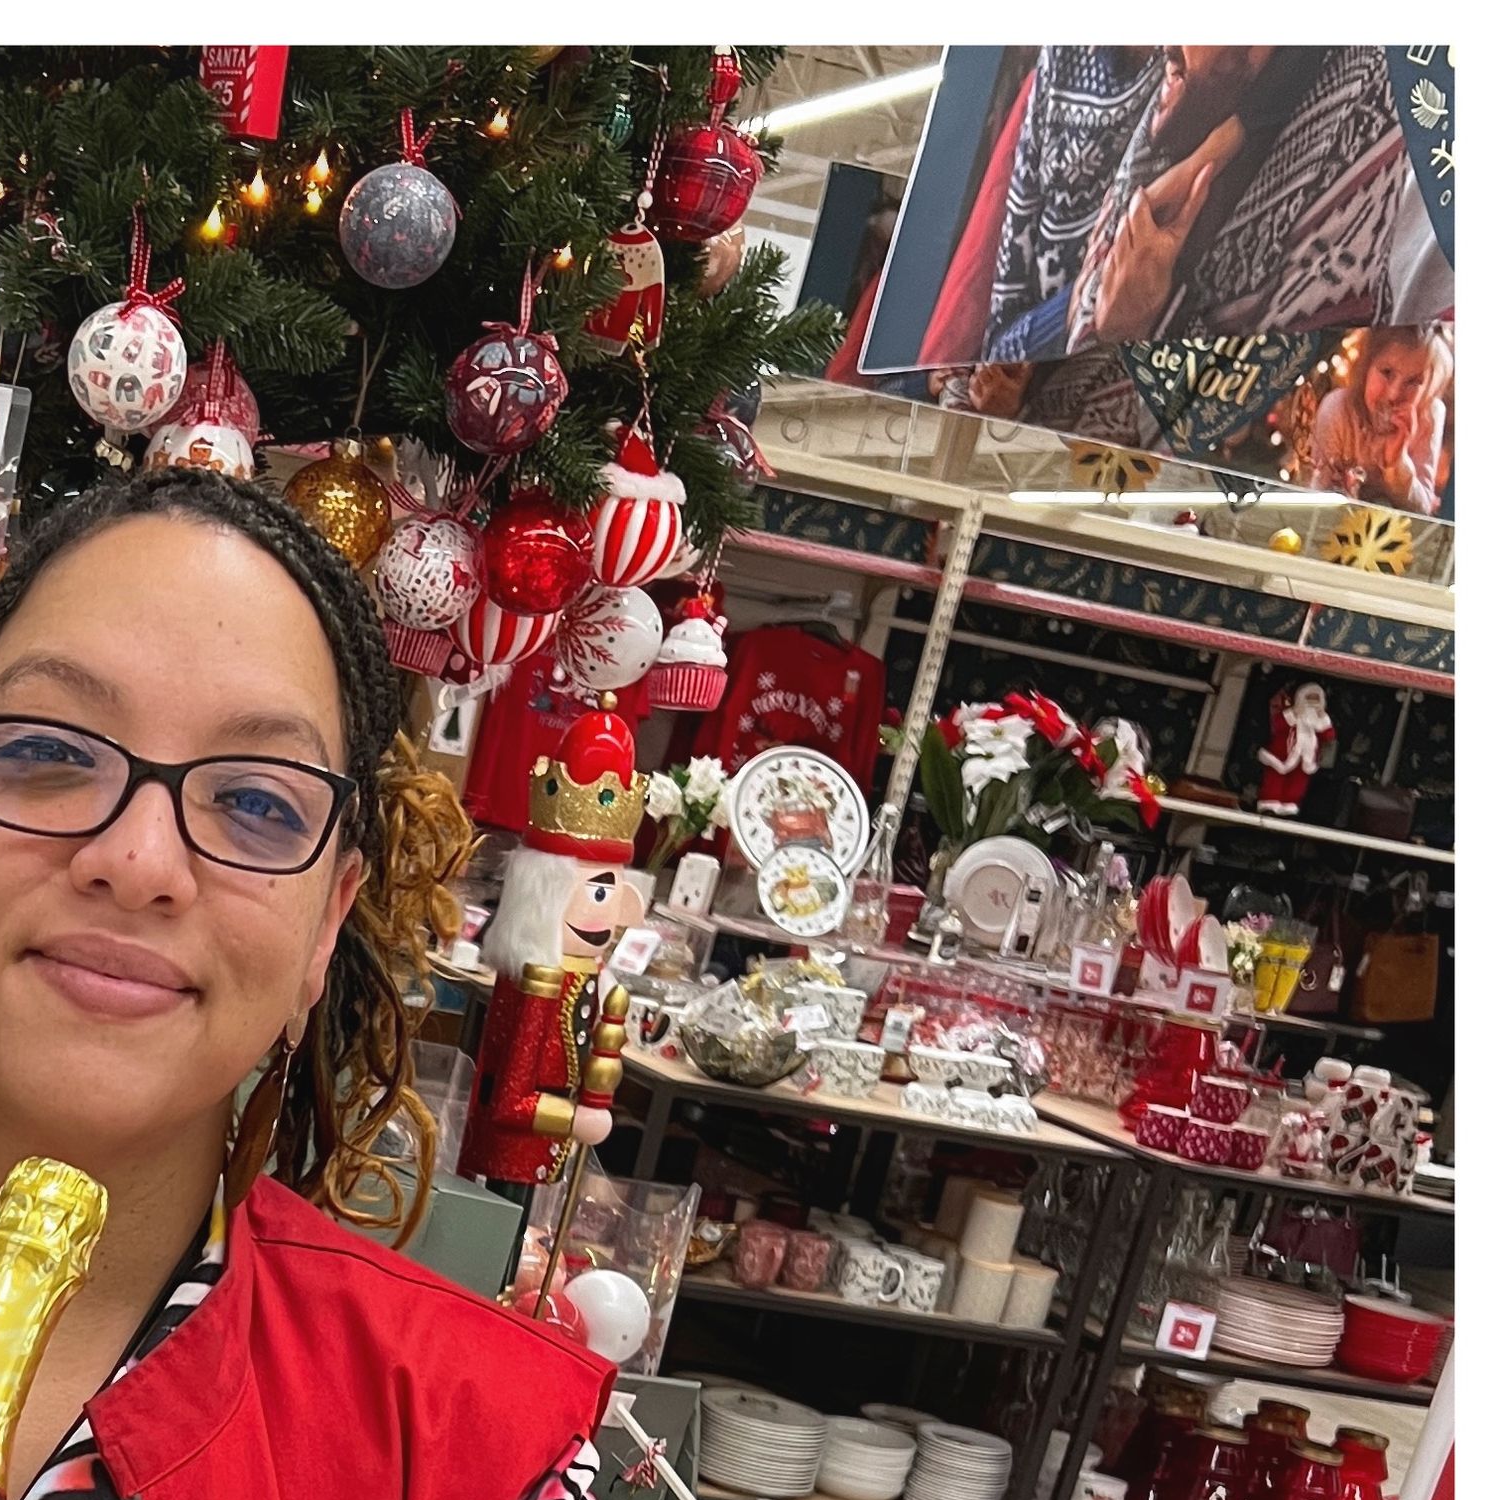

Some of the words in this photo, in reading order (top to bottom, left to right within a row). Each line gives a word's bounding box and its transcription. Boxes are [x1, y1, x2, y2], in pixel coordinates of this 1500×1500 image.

[207, 47, 246, 68] SANTA
[1151, 343, 1182, 372] de
[1171, 350, 1262, 406] Noël
